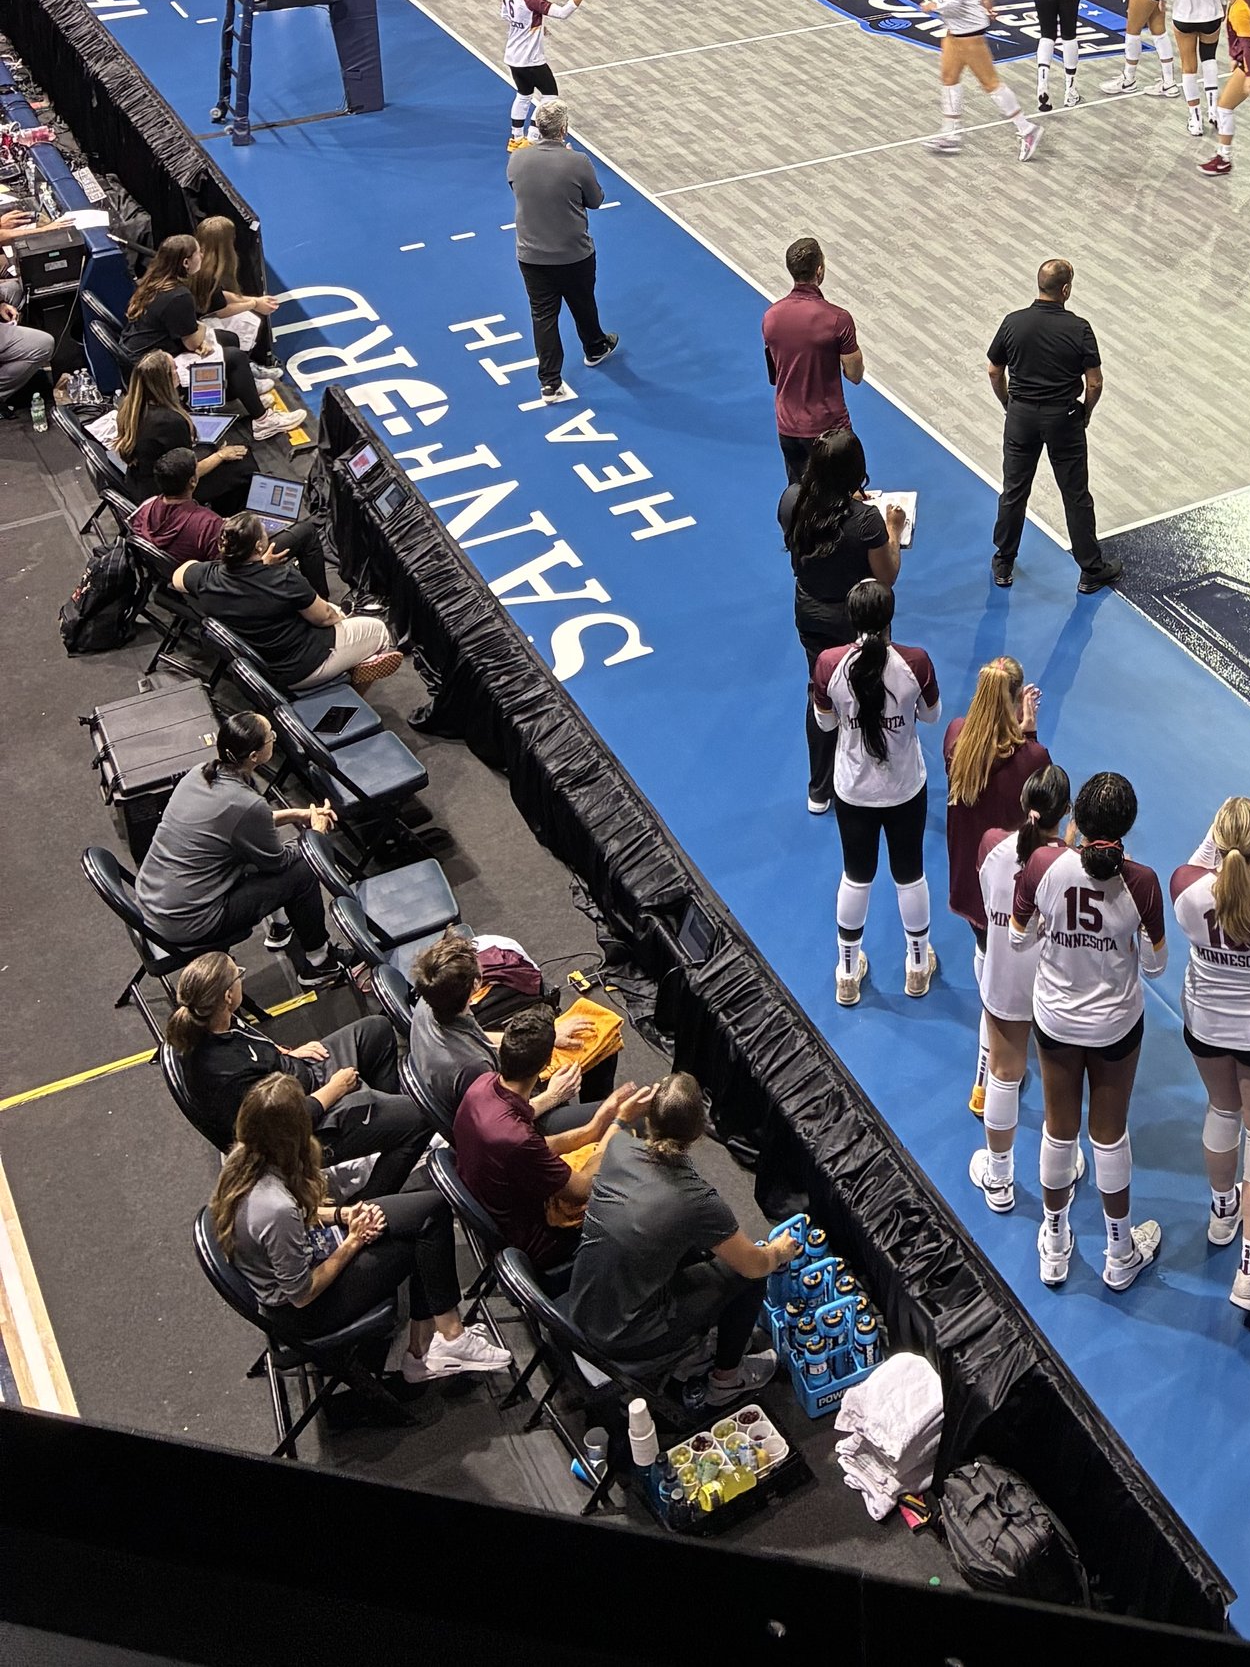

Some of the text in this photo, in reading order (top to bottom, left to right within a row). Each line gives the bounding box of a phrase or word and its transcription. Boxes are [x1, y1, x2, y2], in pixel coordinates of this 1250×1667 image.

[448, 314, 698, 542] HEALTH
[846, 714, 906, 730] MIOTA
[1063, 885, 1103, 934] 15
[1049, 931, 1118, 953] MINNESOTA
